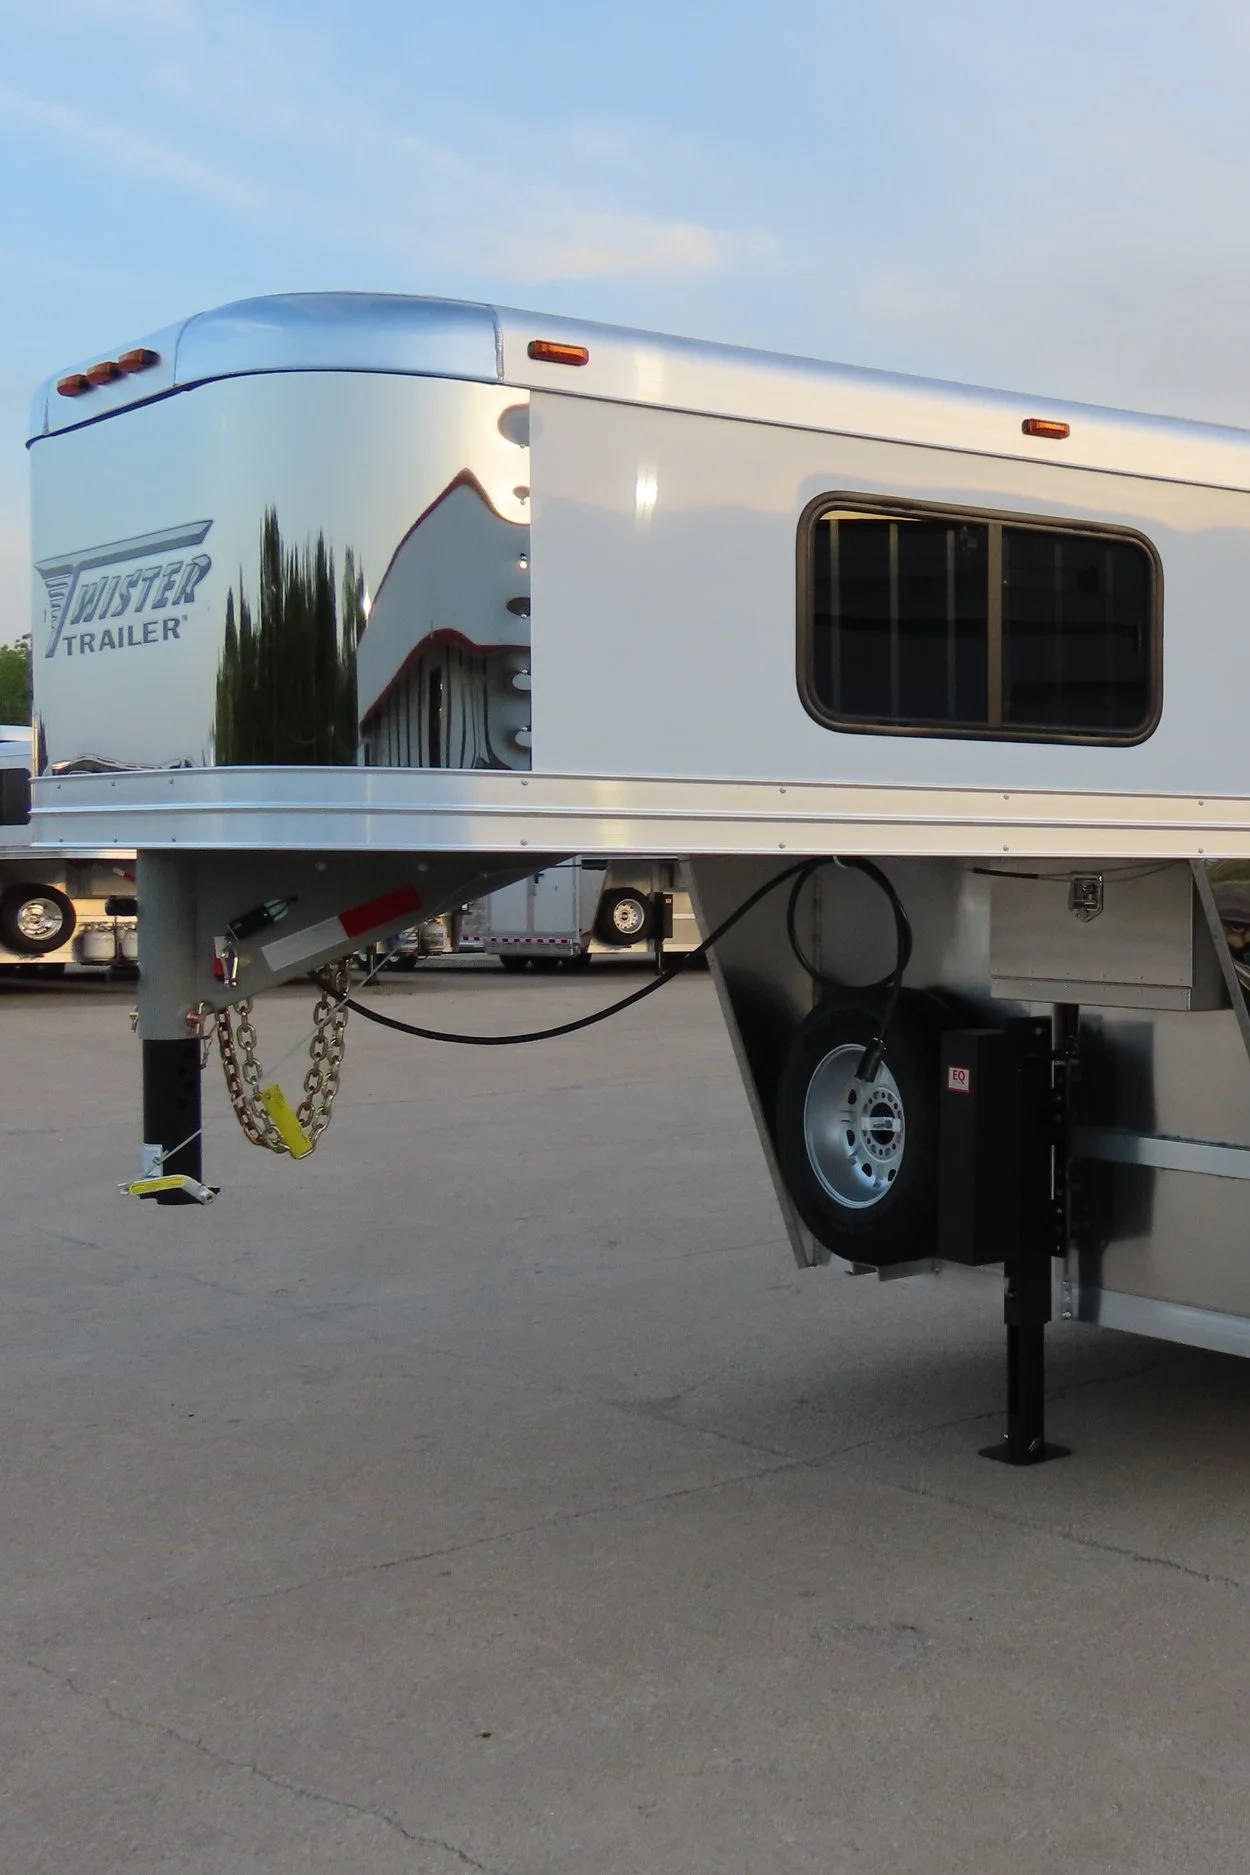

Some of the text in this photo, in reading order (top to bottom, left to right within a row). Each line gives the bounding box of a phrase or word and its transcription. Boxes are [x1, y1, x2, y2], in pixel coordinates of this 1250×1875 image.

[34, 519, 213, 658] TWISTER
[63, 616, 181, 656] TRAILER
[952, 1069, 965, 1085] EQ
